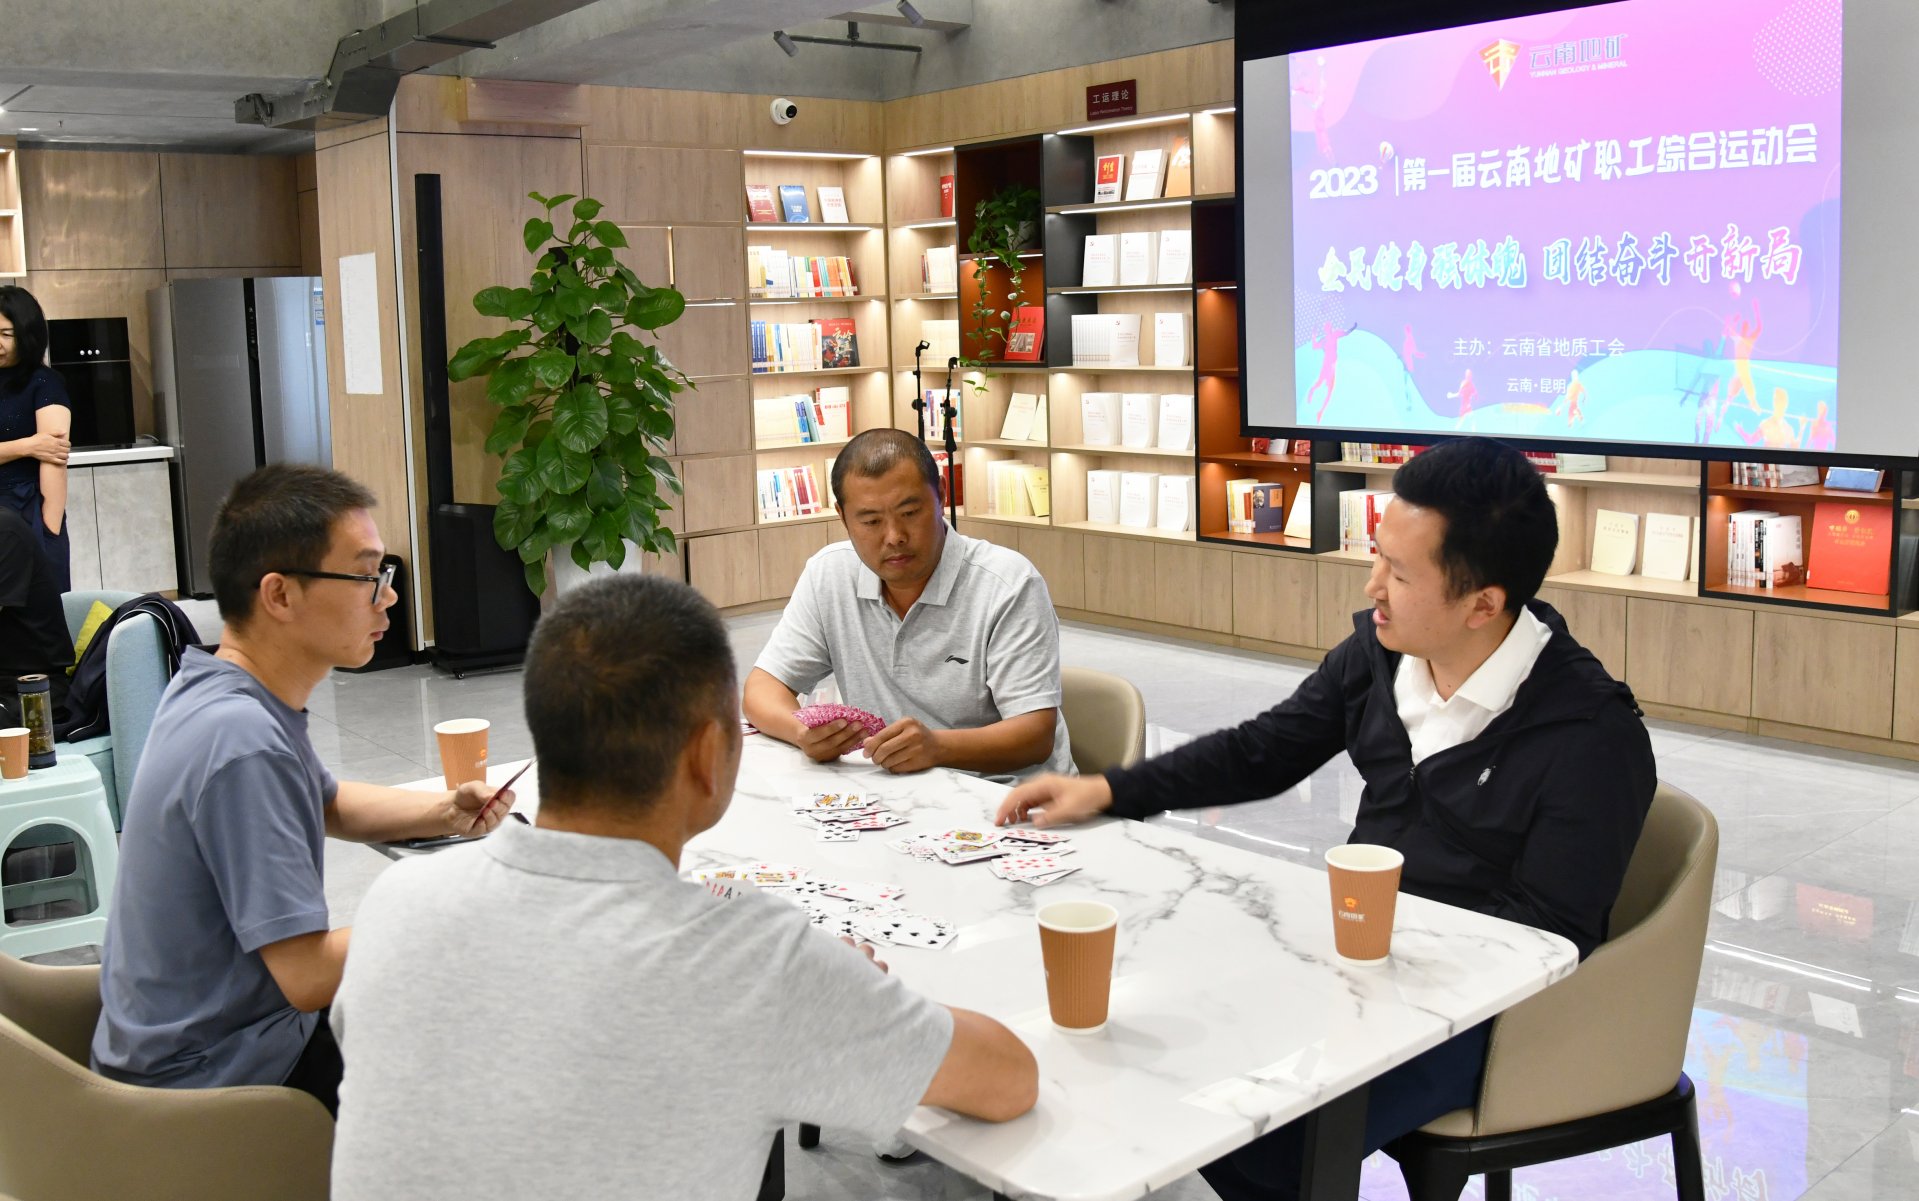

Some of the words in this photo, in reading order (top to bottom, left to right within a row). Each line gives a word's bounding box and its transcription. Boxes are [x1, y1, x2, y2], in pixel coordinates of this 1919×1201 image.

[1558, 65, 1590, 75] GEOLOGY
[1092, 89, 1129, 103] 工运理论
[1309, 164, 1379, 199] 2023
[1403, 123, 1818, 191] 第一届云南地矿职工综合运动会
